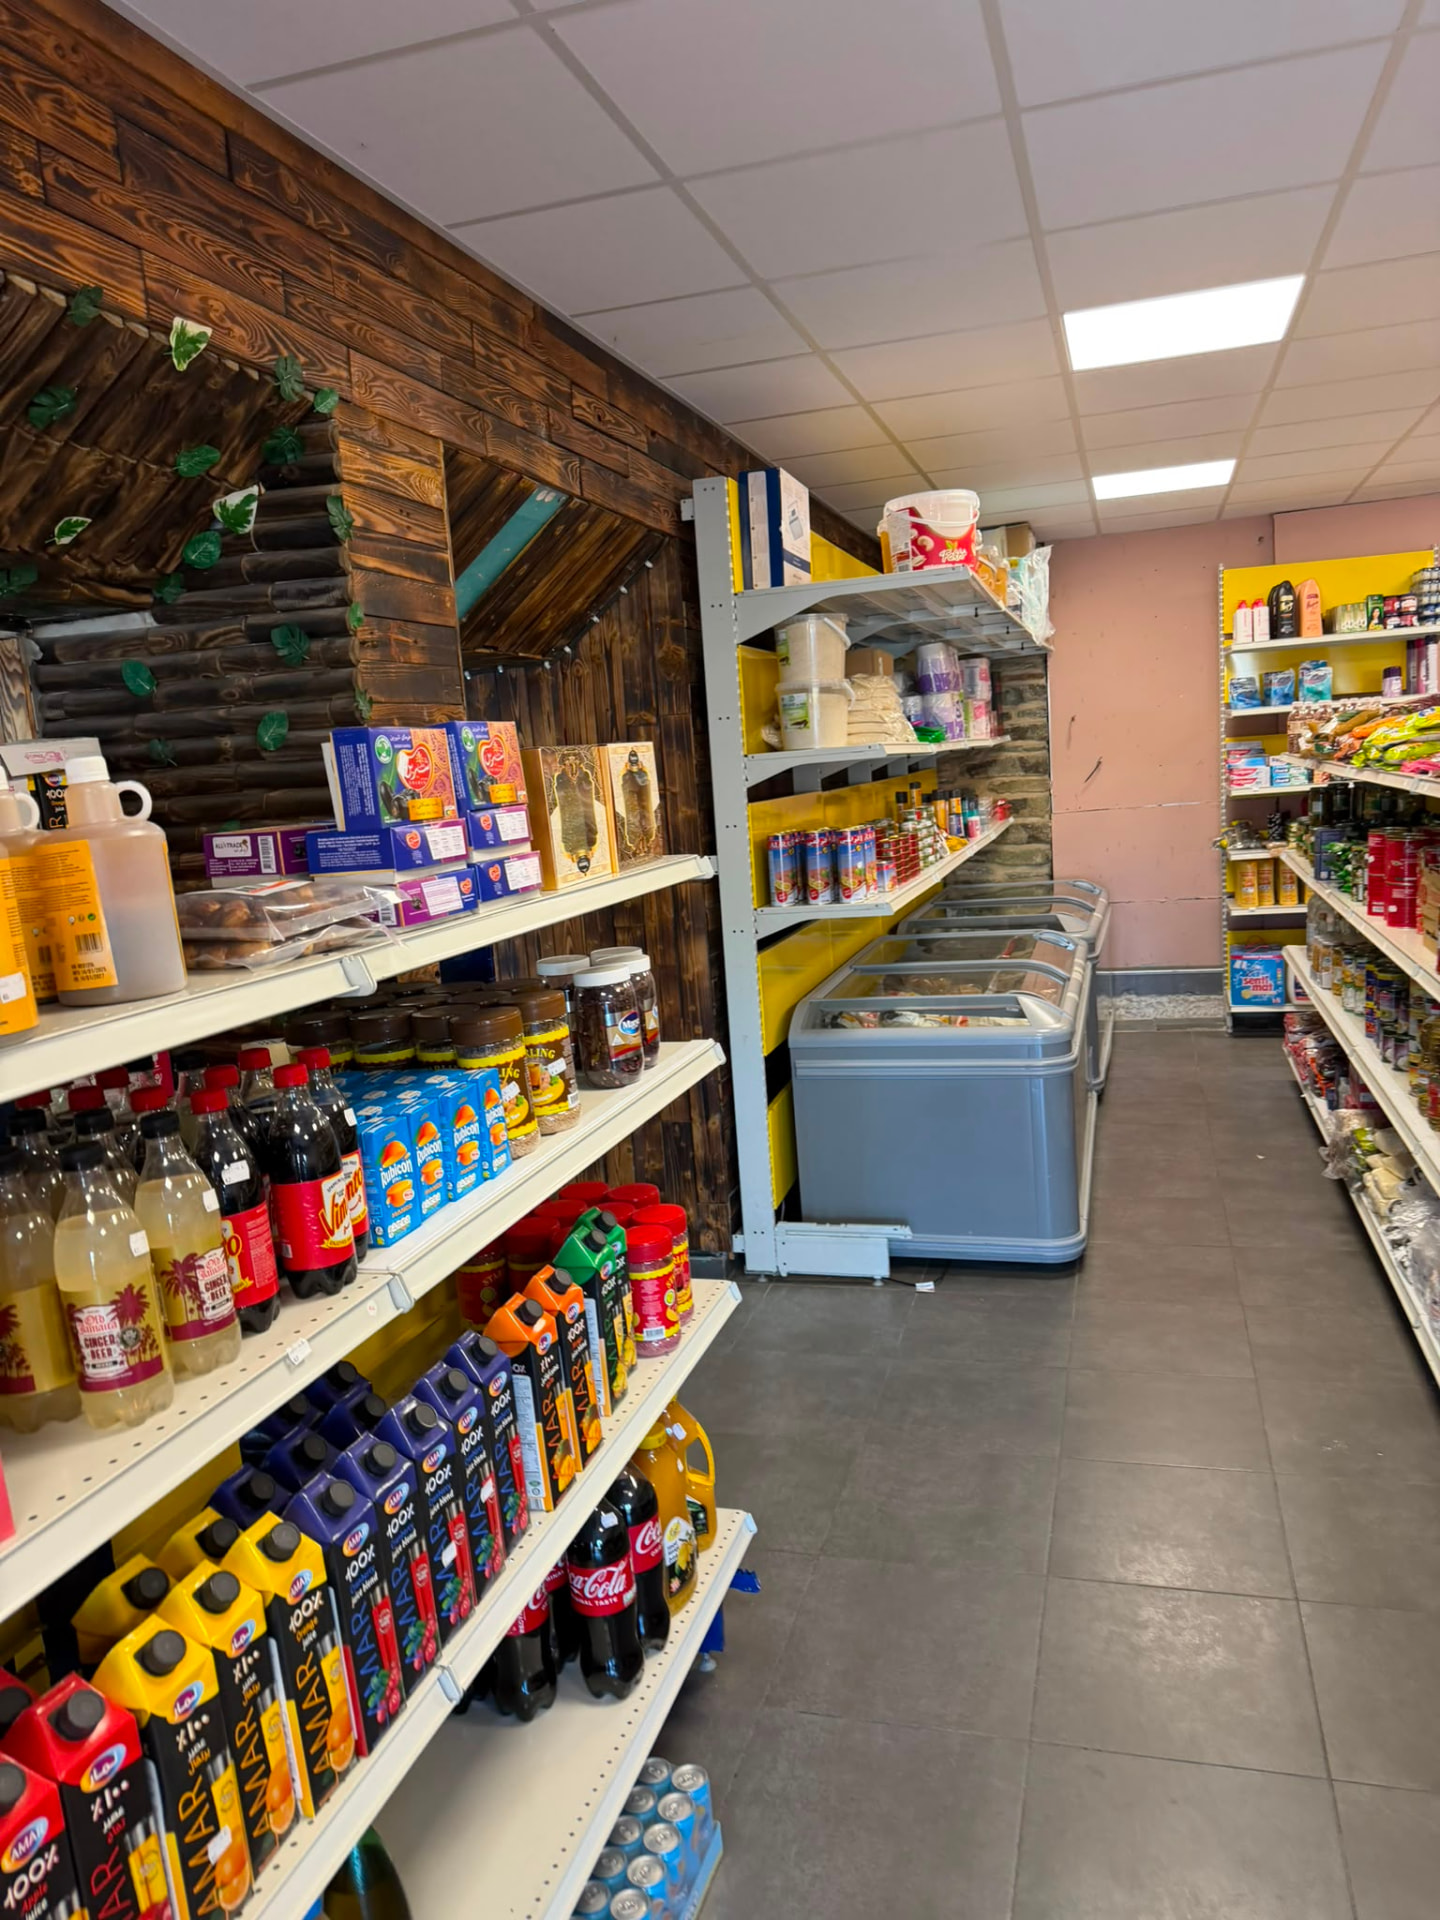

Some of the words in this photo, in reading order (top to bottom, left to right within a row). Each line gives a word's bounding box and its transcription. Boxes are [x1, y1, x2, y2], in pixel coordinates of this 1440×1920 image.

[525, 1048, 556, 1059] RLING
[499, 1067, 520, 1079] LING
[453, 1122, 480, 1148] Rubicon
[416, 1138, 443, 1166] Rubicon
[379, 1159, 413, 1189] Rubicon
[319, 1191, 347, 1238] Vim
[204, 1274, 226, 1292] GINGER
[210, 1286, 227, 1301] BEER
[84, 1334, 115, 1349] GINGER
[567, 1319, 585, 1342] 100%
[90, 1348, 113, 1360] BEER
[512, 1364, 526, 1373] 0%
[491, 1389, 511, 1417] 100%
[461, 1425, 484, 1455] 100%
[425, 1464, 452, 1497] 100%
[440, 1489, 455, 1507] blend
[386, 1502, 415, 1538] 100%
[392, 1544, 405, 1563] juice
[404, 1528, 417, 1548] blend
[345, 1543, 375, 1583] 100%
[289, 1573, 312, 1598] AMAR
[351, 1587, 365, 1609] juice
[363, 1571, 379, 1594] blend
[570, 1561, 626, 1599] ca-Cola
[289, 1590, 324, 1633] 100%
[594, 1596, 618, 1606] TASTE
[295, 1616, 318, 1643] Orange
[302, 1629, 318, 1652] juice
[295, 1651, 331, 1775] AMAR
[235, 1706, 270, 1838] AMAR
[4, 1844, 59, 1910] 100%
[90, 1845, 134, 1920] AR
[21, 1882, 48, 1917] Apple
